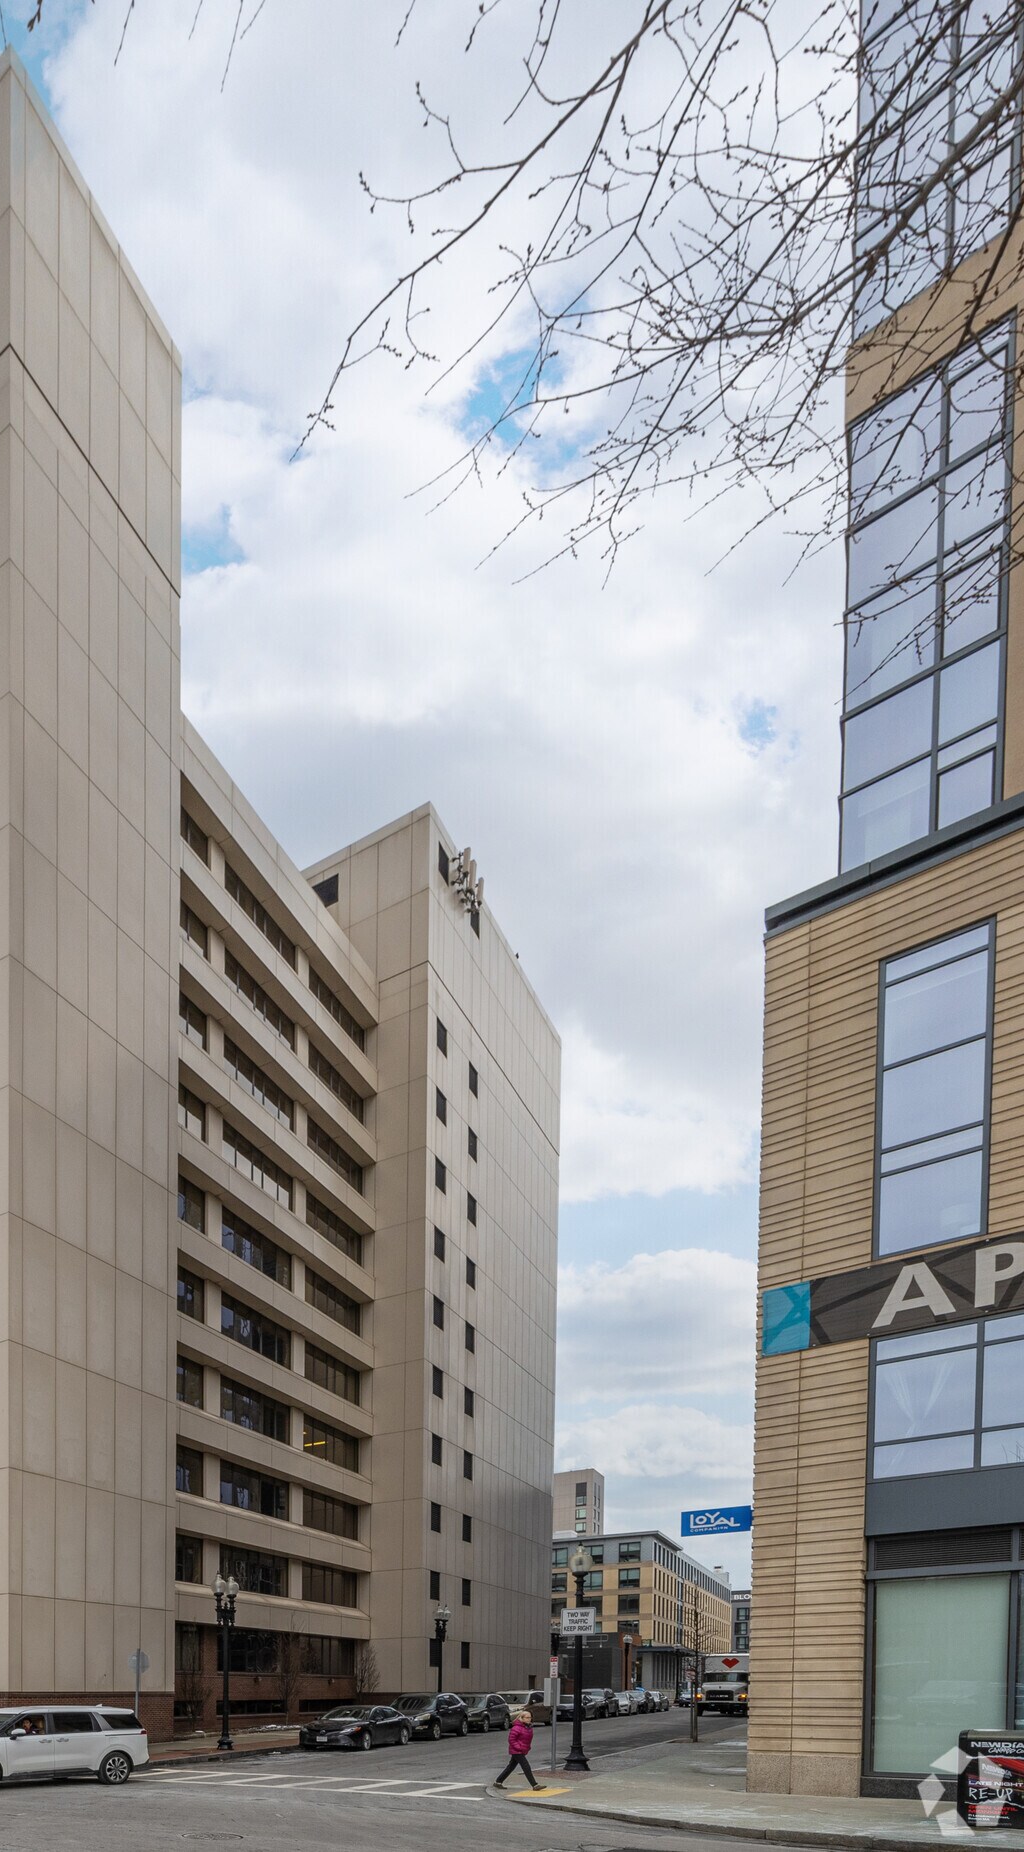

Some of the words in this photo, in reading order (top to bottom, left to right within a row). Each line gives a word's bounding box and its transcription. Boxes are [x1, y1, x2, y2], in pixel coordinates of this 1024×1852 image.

[871, 1242, 1024, 1329] AP
[690, 1511, 740, 1528] LOYAL
[969, 1787, 1013, 1801] RE-UP
